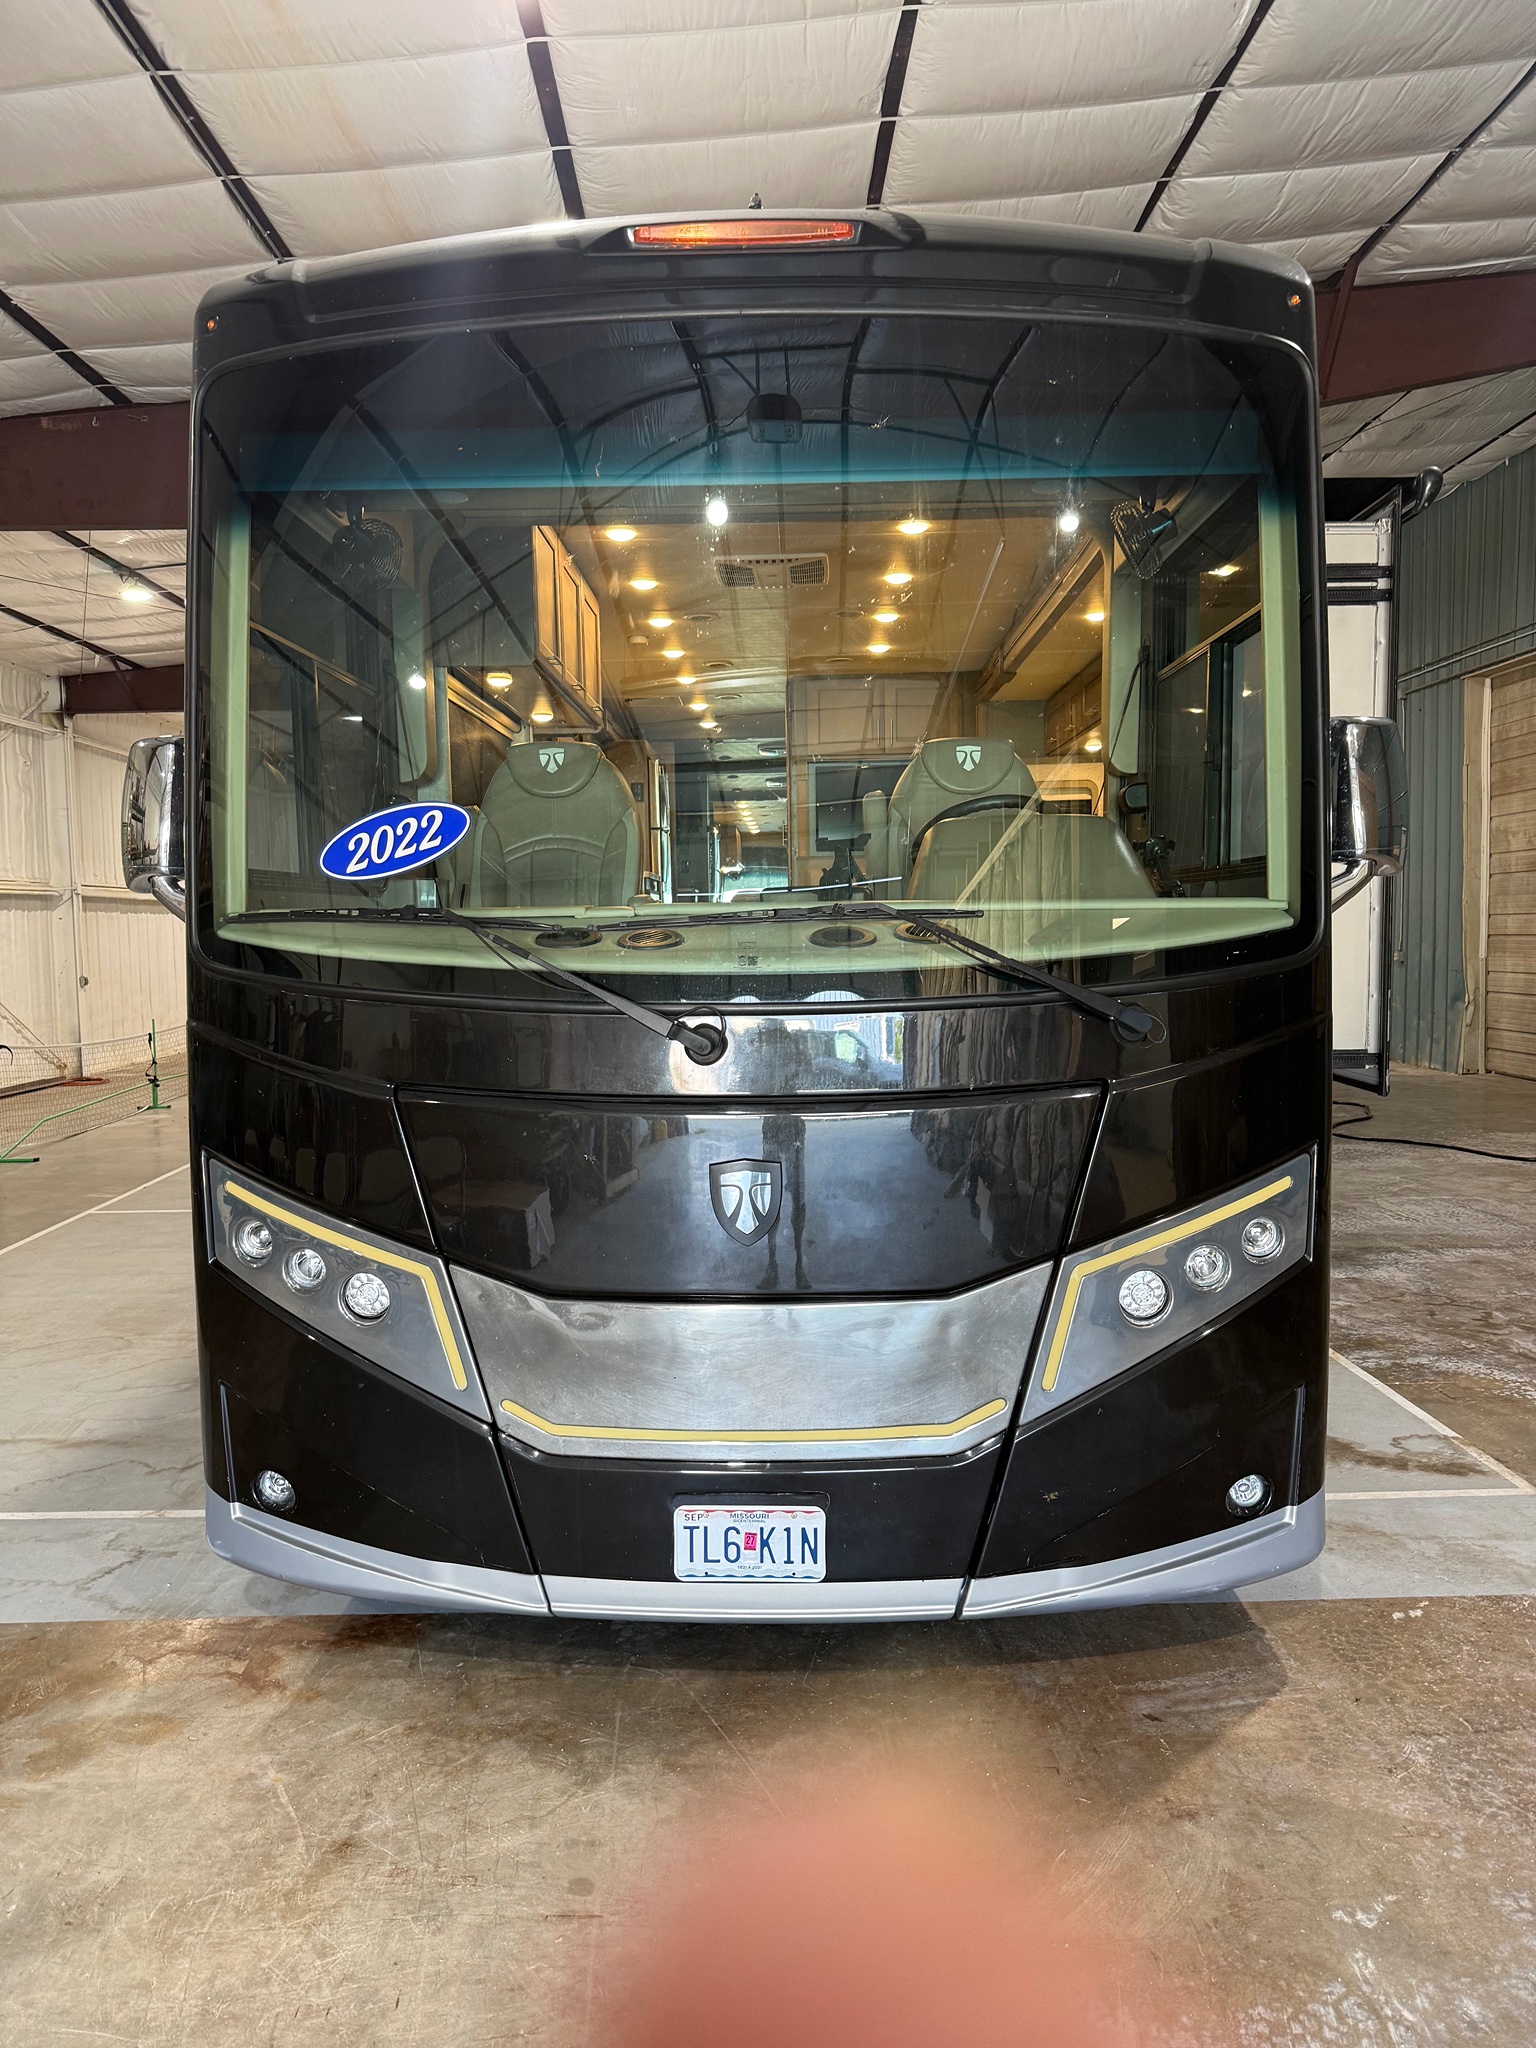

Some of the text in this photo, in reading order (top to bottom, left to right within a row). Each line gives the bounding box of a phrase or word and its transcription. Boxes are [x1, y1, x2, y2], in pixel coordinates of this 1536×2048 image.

[345, 809, 444, 874] 2022
[684, 1513, 703, 1521] SEP
[683, 1525, 741, 1564] TL6
[745, 1535, 755, 1546] 27
